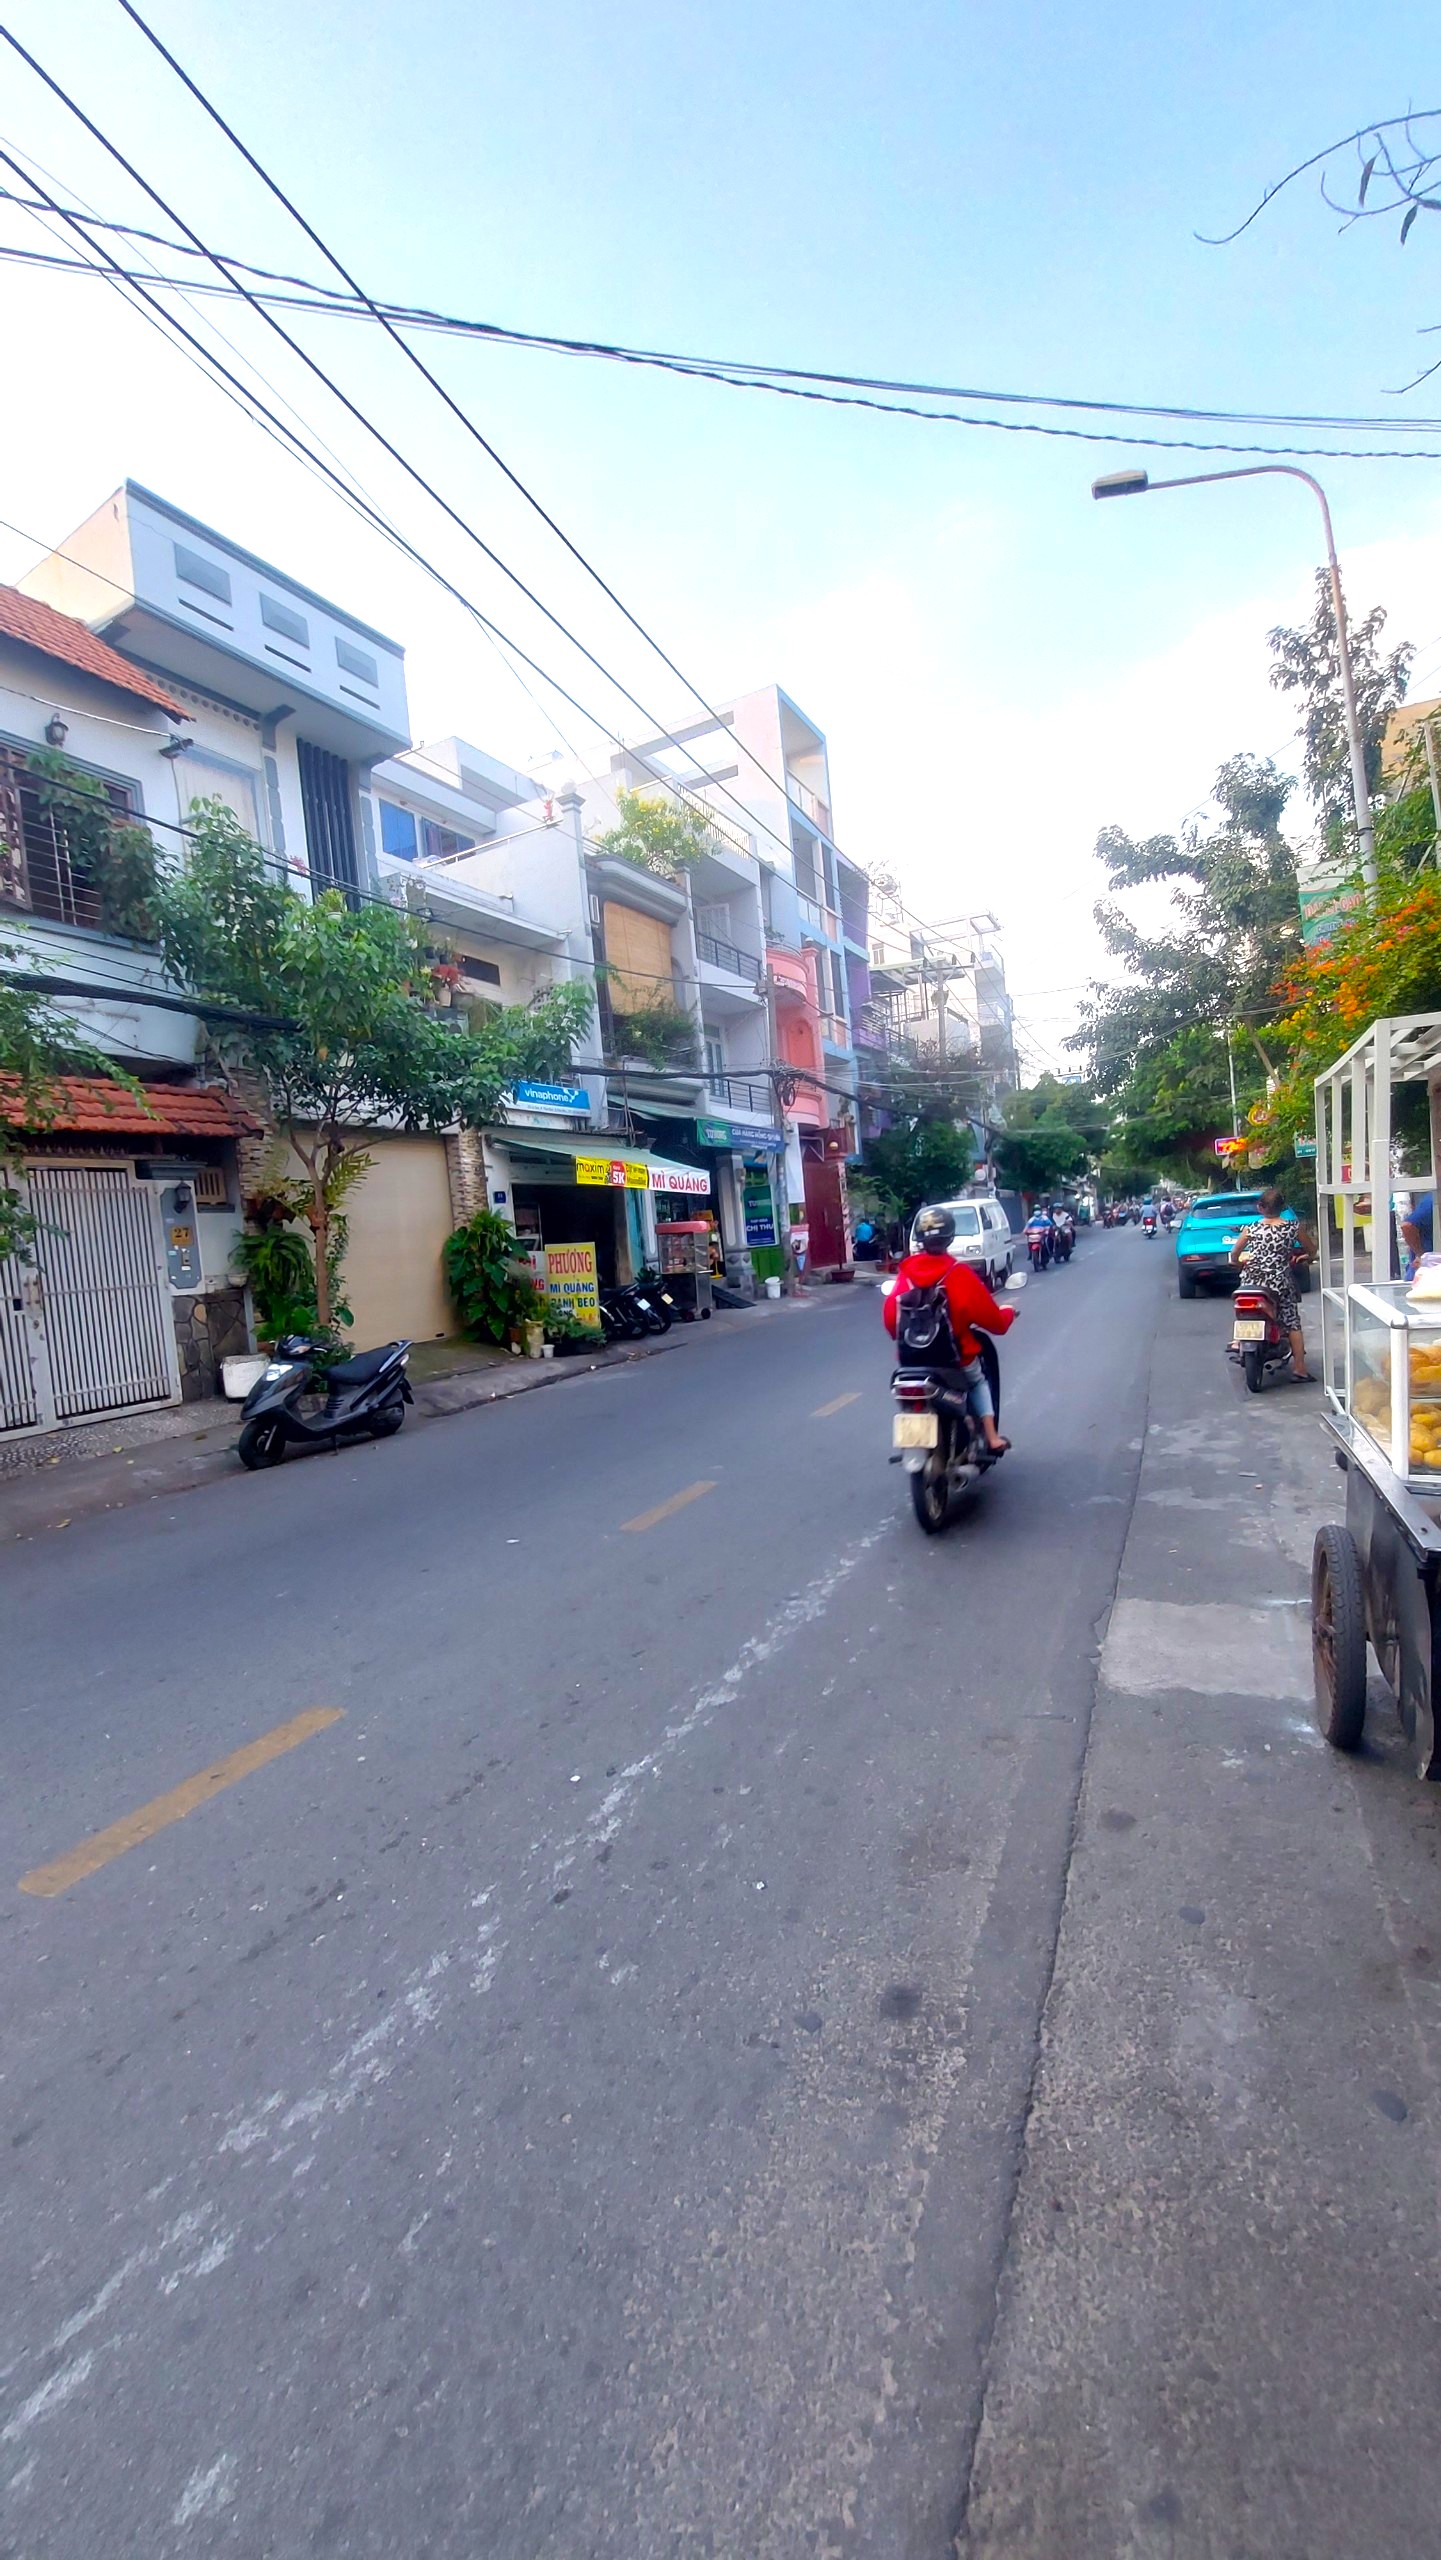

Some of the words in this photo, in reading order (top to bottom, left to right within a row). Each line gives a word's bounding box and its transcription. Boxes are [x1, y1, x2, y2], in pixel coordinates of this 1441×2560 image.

[525, 1088, 568, 1102] vinaphone
[577, 1161, 605, 1174] maxim
[612, 1171, 625, 1184] 5K
[652, 1170, 666, 1188] MÌ
[174, 1227, 189, 1238] 27
[550, 1281, 561, 1293] MÌ
